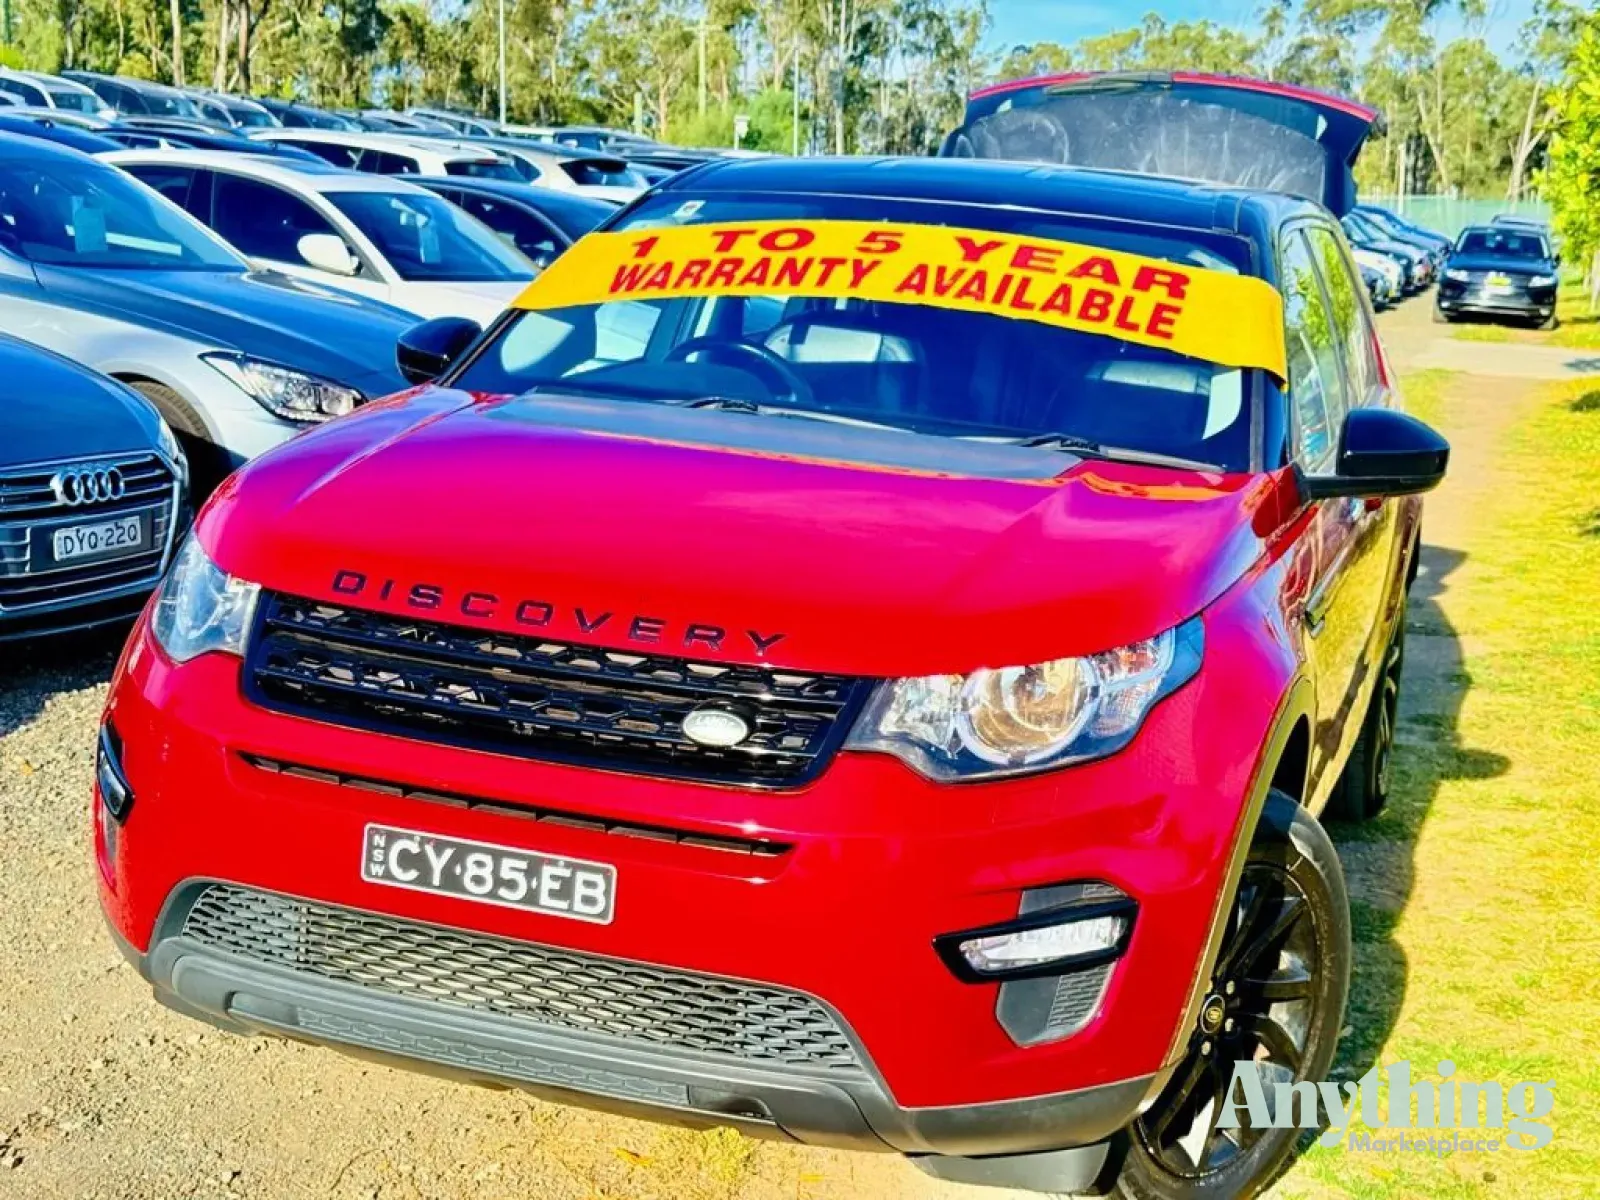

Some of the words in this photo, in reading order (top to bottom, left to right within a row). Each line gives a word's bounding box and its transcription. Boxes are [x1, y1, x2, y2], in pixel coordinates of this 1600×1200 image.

[608, 257, 882, 293] WARRANTY
[894, 263, 1182, 340] AVAILABLE
[631, 236, 660, 258] 1
[711, 228, 816, 253] TO
[855, 231, 905, 254] 5
[955, 236, 1191, 300] YEAR
[331, 569, 787, 657] DISCOVERY
[370, 834, 386, 878] NSW
